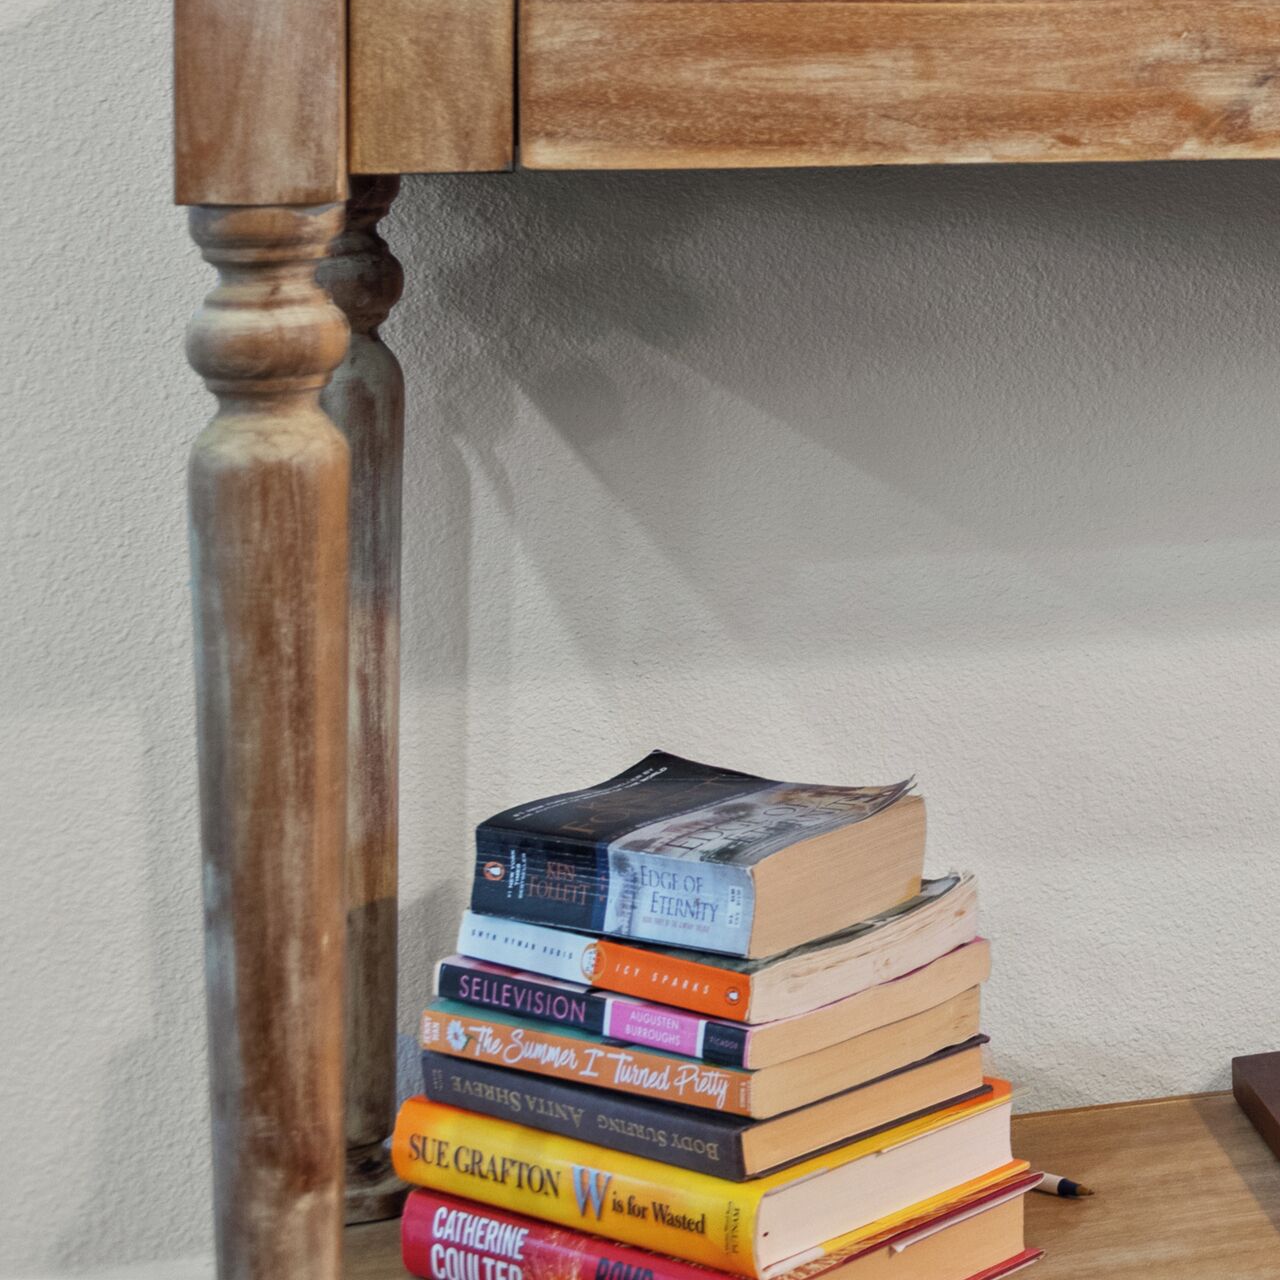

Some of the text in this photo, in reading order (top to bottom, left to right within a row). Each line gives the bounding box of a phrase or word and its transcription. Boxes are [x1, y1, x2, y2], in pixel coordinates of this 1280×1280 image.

[546, 861, 576, 882] KEN
[640, 866, 704, 893] EDGE OF
[528, 877, 590, 906] FOLLETT
[650, 894, 719, 923] ETERNITY
[615, 963, 711, 995] ICY SPARKS
[458, 975, 587, 1024] SELLEVISION
[624, 1023, 681, 1048] BURROUGHS
[628, 1010, 679, 1031] AUGUSTEN
[468, 1025, 503, 1057] The
[504, 1028, 579, 1070] Summer
[578, 1048, 604, 1077] I
[606, 1053, 670, 1092] Turned
[673, 1064, 731, 1111] Pretty
[451, 1076, 522, 1112] SHREVE
[526, 1094, 585, 1128] ANITA
[596, 1114, 720, 1161] BODY SURFING
[408, 1132, 450, 1168] SUE
[453, 1144, 562, 1198] GRAFTON
[570, 1163, 613, 1221] W
[612, 1190, 625, 1213] is
[626, 1194, 649, 1219] for
[651, 1200, 706, 1235] Wasted
[432, 1206, 529, 1260] CATHERINE
